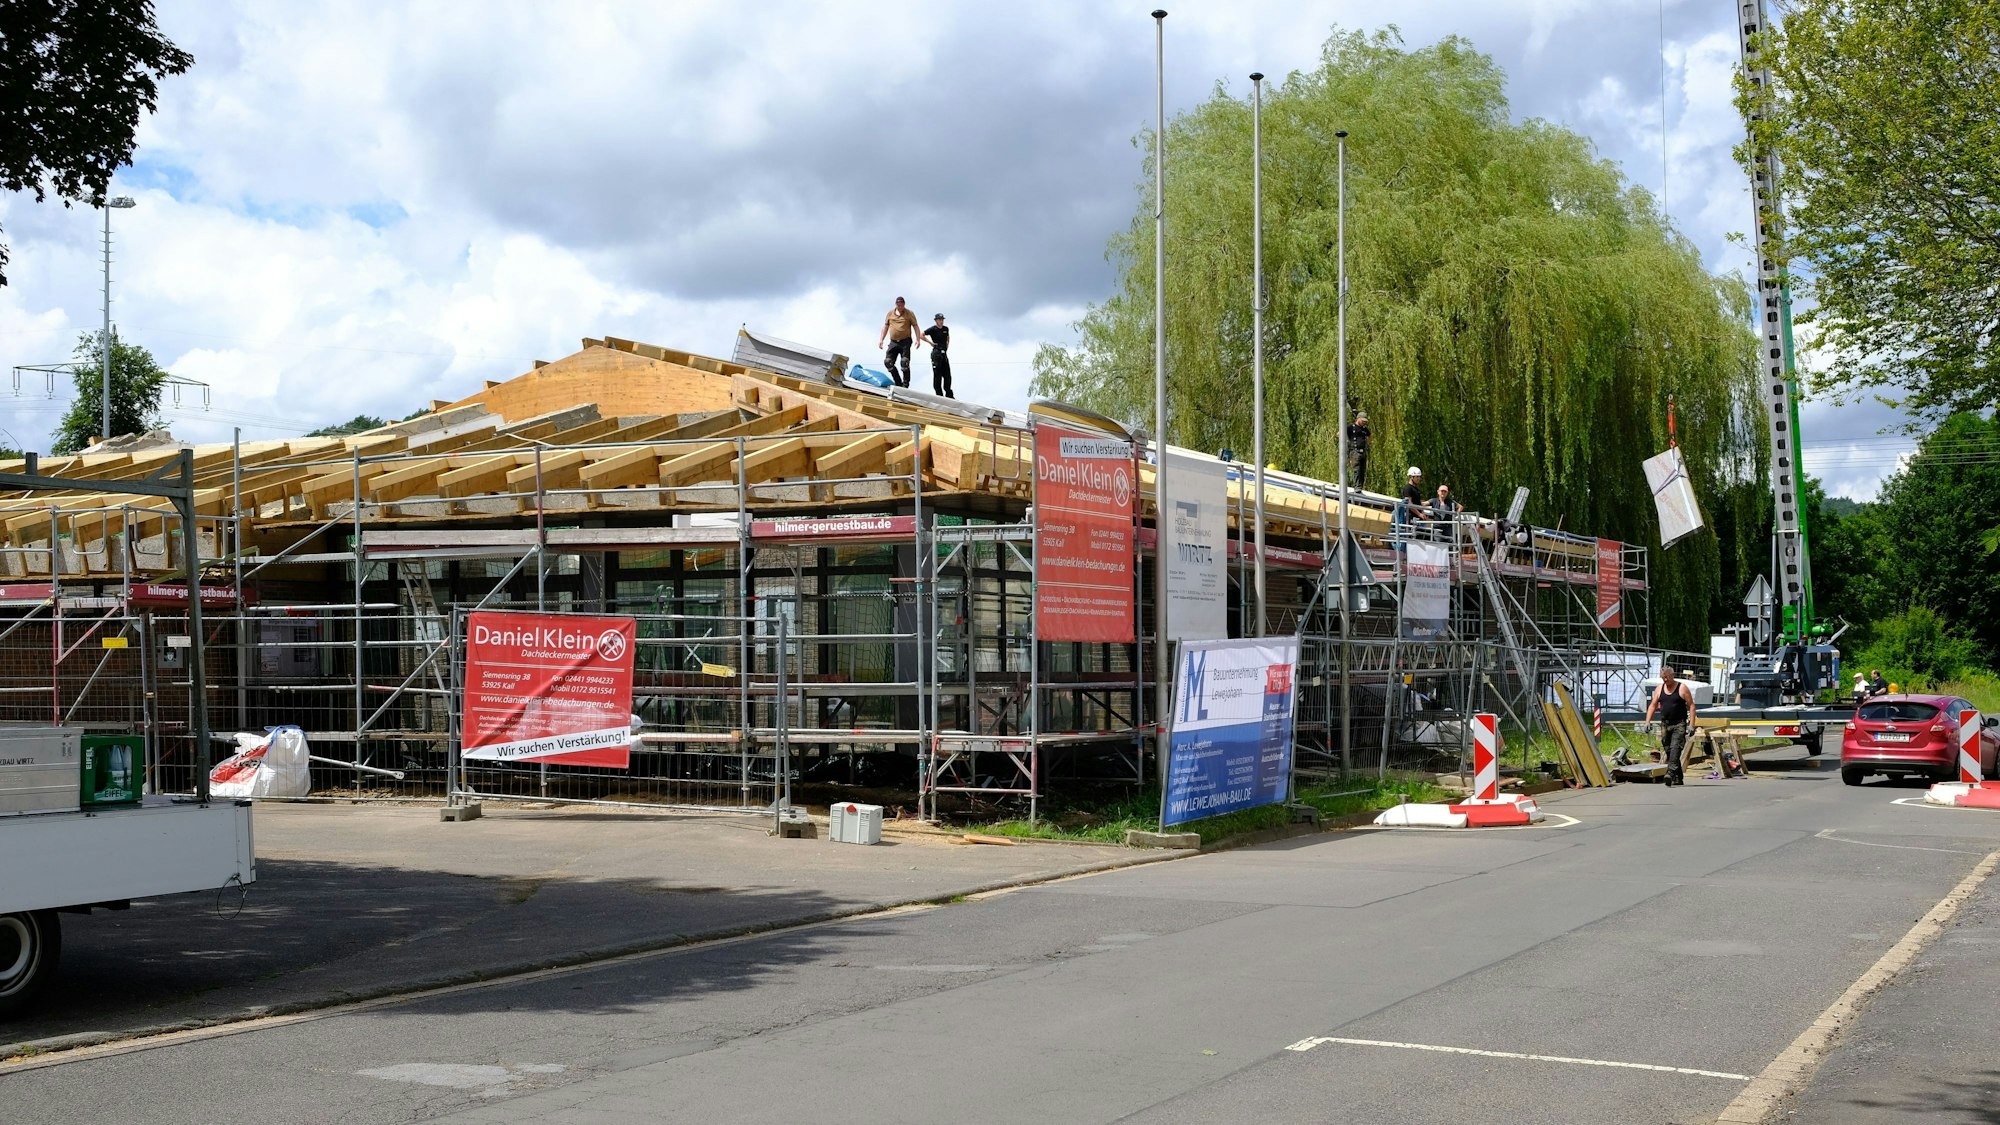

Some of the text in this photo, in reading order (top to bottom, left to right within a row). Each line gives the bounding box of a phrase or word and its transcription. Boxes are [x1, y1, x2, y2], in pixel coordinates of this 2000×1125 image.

[775, 519, 892, 534] hilmer-geruestbau.de
[521, 650, 592, 660] Dachdeckermeister
[482, 672, 532, 681] Siemensring 38
[1213, 666, 1258, 681] Bauunternehmung
[586, 676, 615, 685] 9944233
[502, 682, 516, 690] Kall
[571, 686, 588, 694] 0172
[497, 731, 626, 758] Wir suchen Verstärkung!
